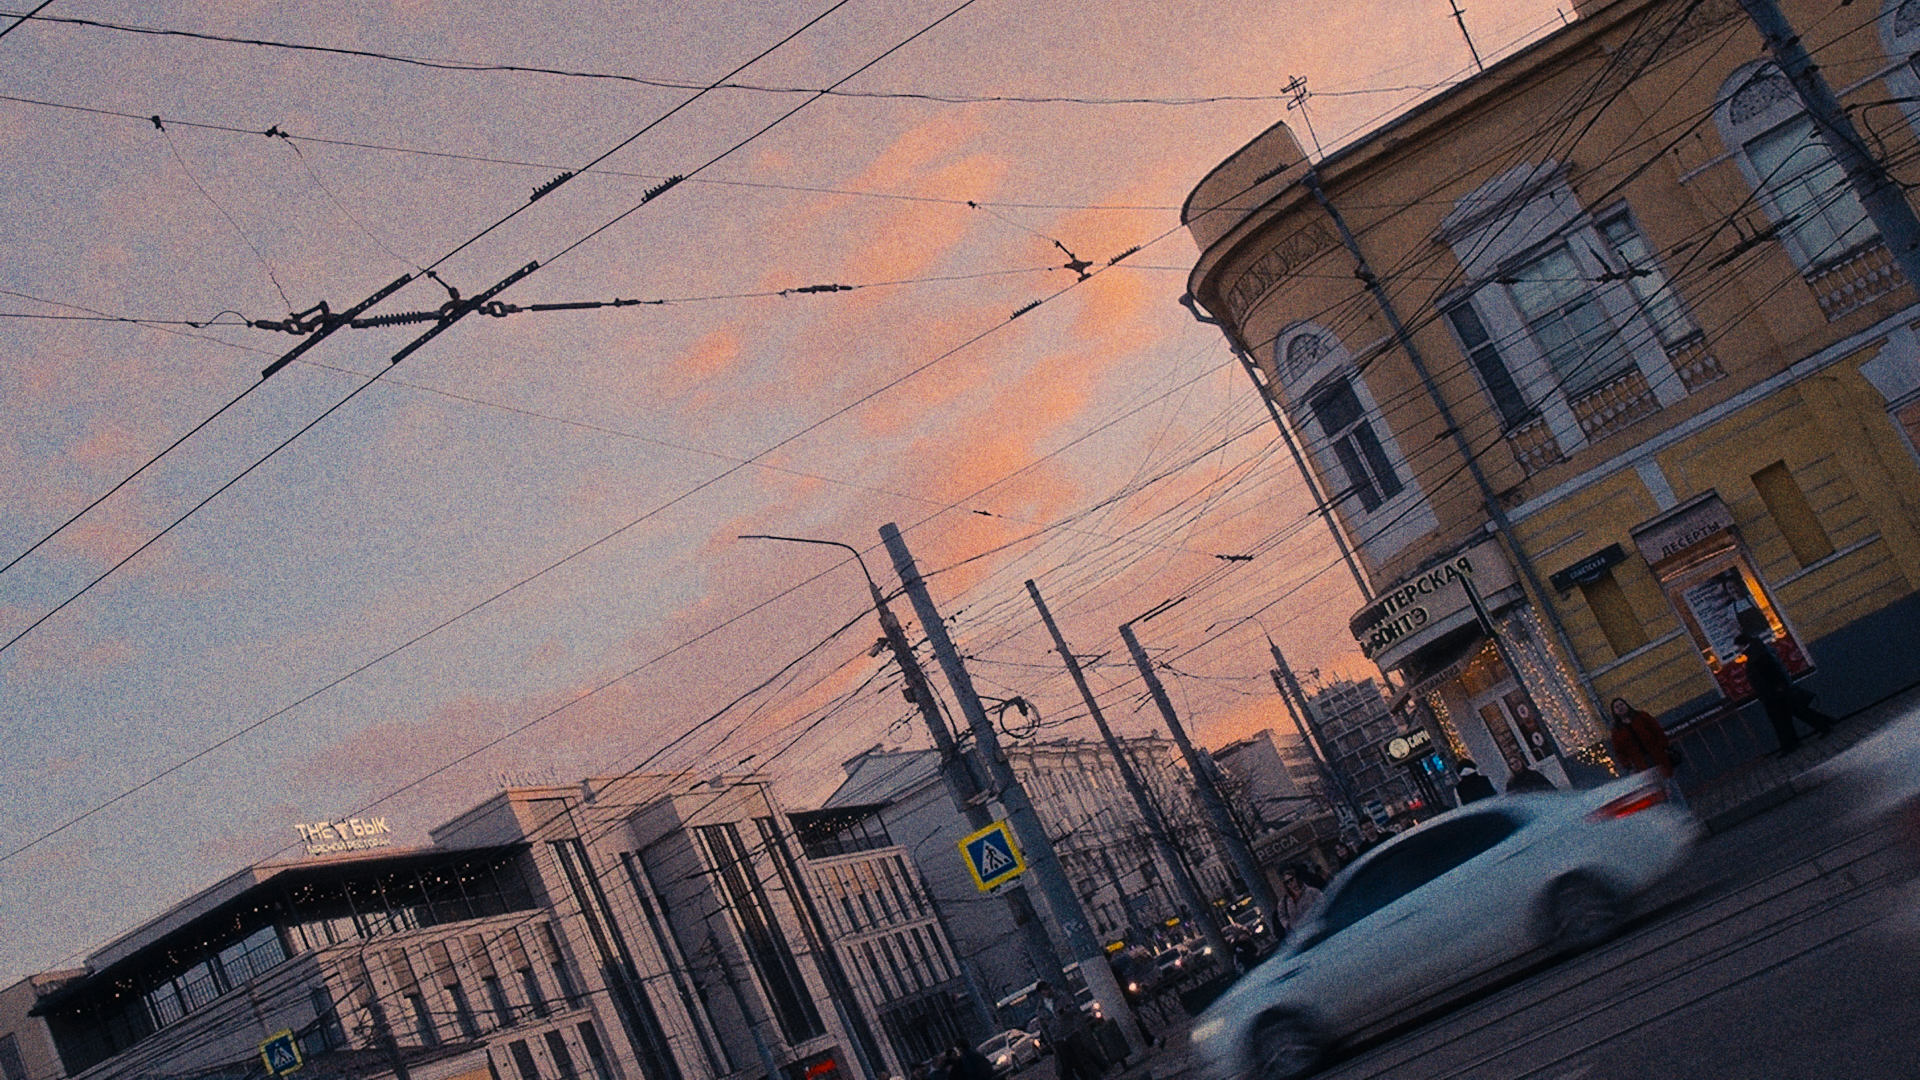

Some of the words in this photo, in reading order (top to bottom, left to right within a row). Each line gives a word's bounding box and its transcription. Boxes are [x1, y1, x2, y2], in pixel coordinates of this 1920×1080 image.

[1661, 521, 1720, 558] ДЕСЕРТЫ
[294, 821, 334, 841] THE
[349, 817, 391, 837] БЫК
[1256, 834, 1299, 860] РЕССА
